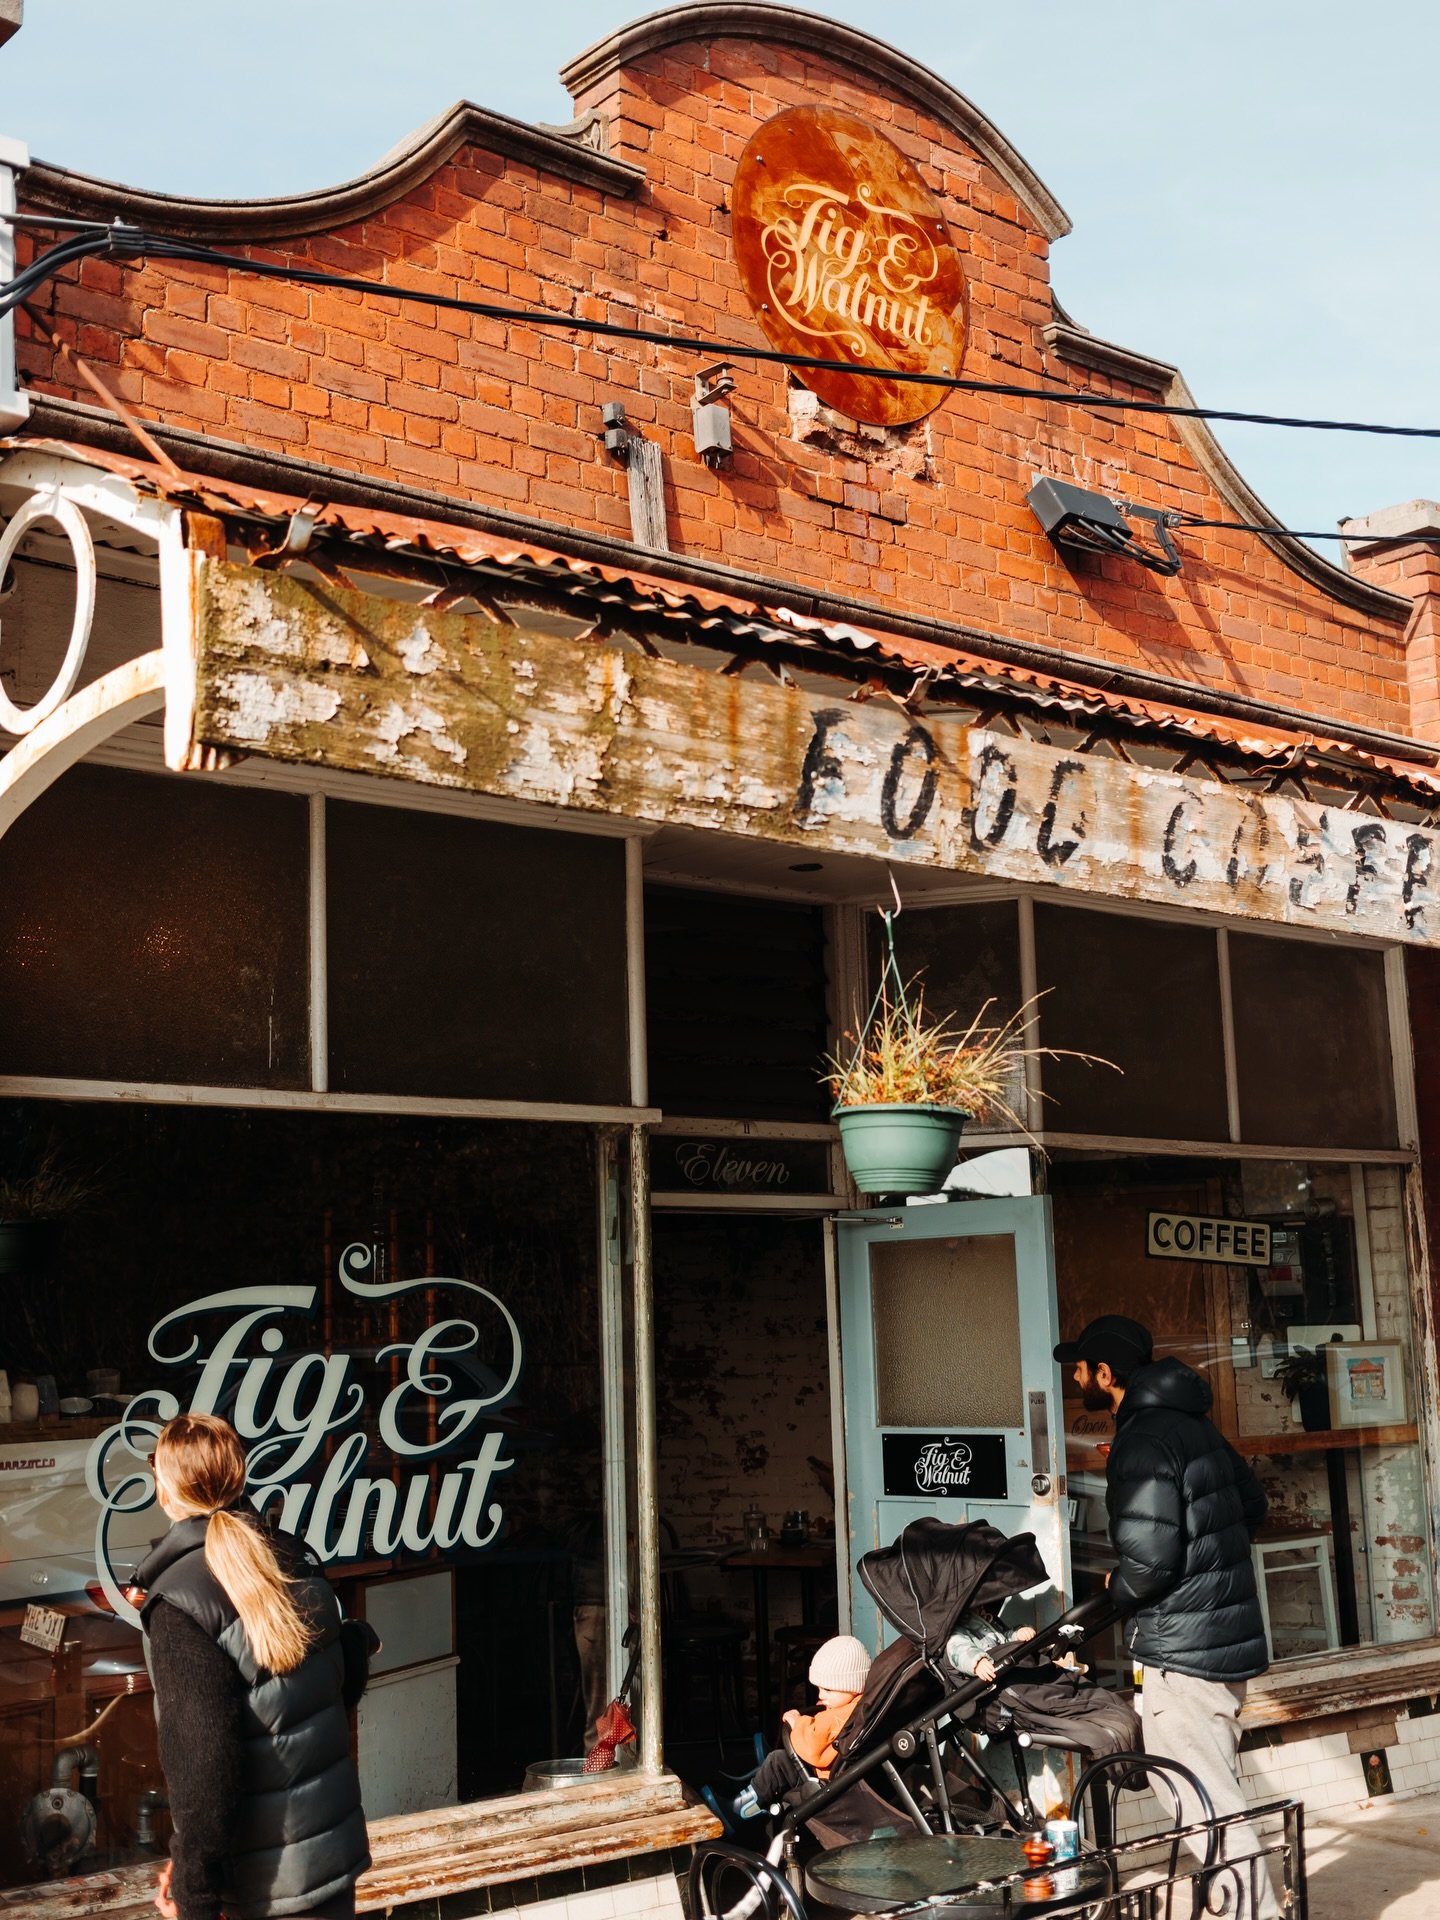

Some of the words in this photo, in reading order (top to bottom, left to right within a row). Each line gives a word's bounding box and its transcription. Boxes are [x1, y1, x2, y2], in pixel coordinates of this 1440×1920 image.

[783, 184, 870, 279] Fig
[857, 182, 938, 293] &
[761, 217, 932, 357] Walnut
[675, 1142, 790, 1185] Eleven
[1153, 1217, 1268, 1258] COFFEE
[147, 1285, 363, 1485] Fig
[339, 1242, 523, 1455] &
[921, 1443, 949, 1471] Fig
[944, 1437, 972, 1470] &
[914, 1459, 971, 1495] Walnut
